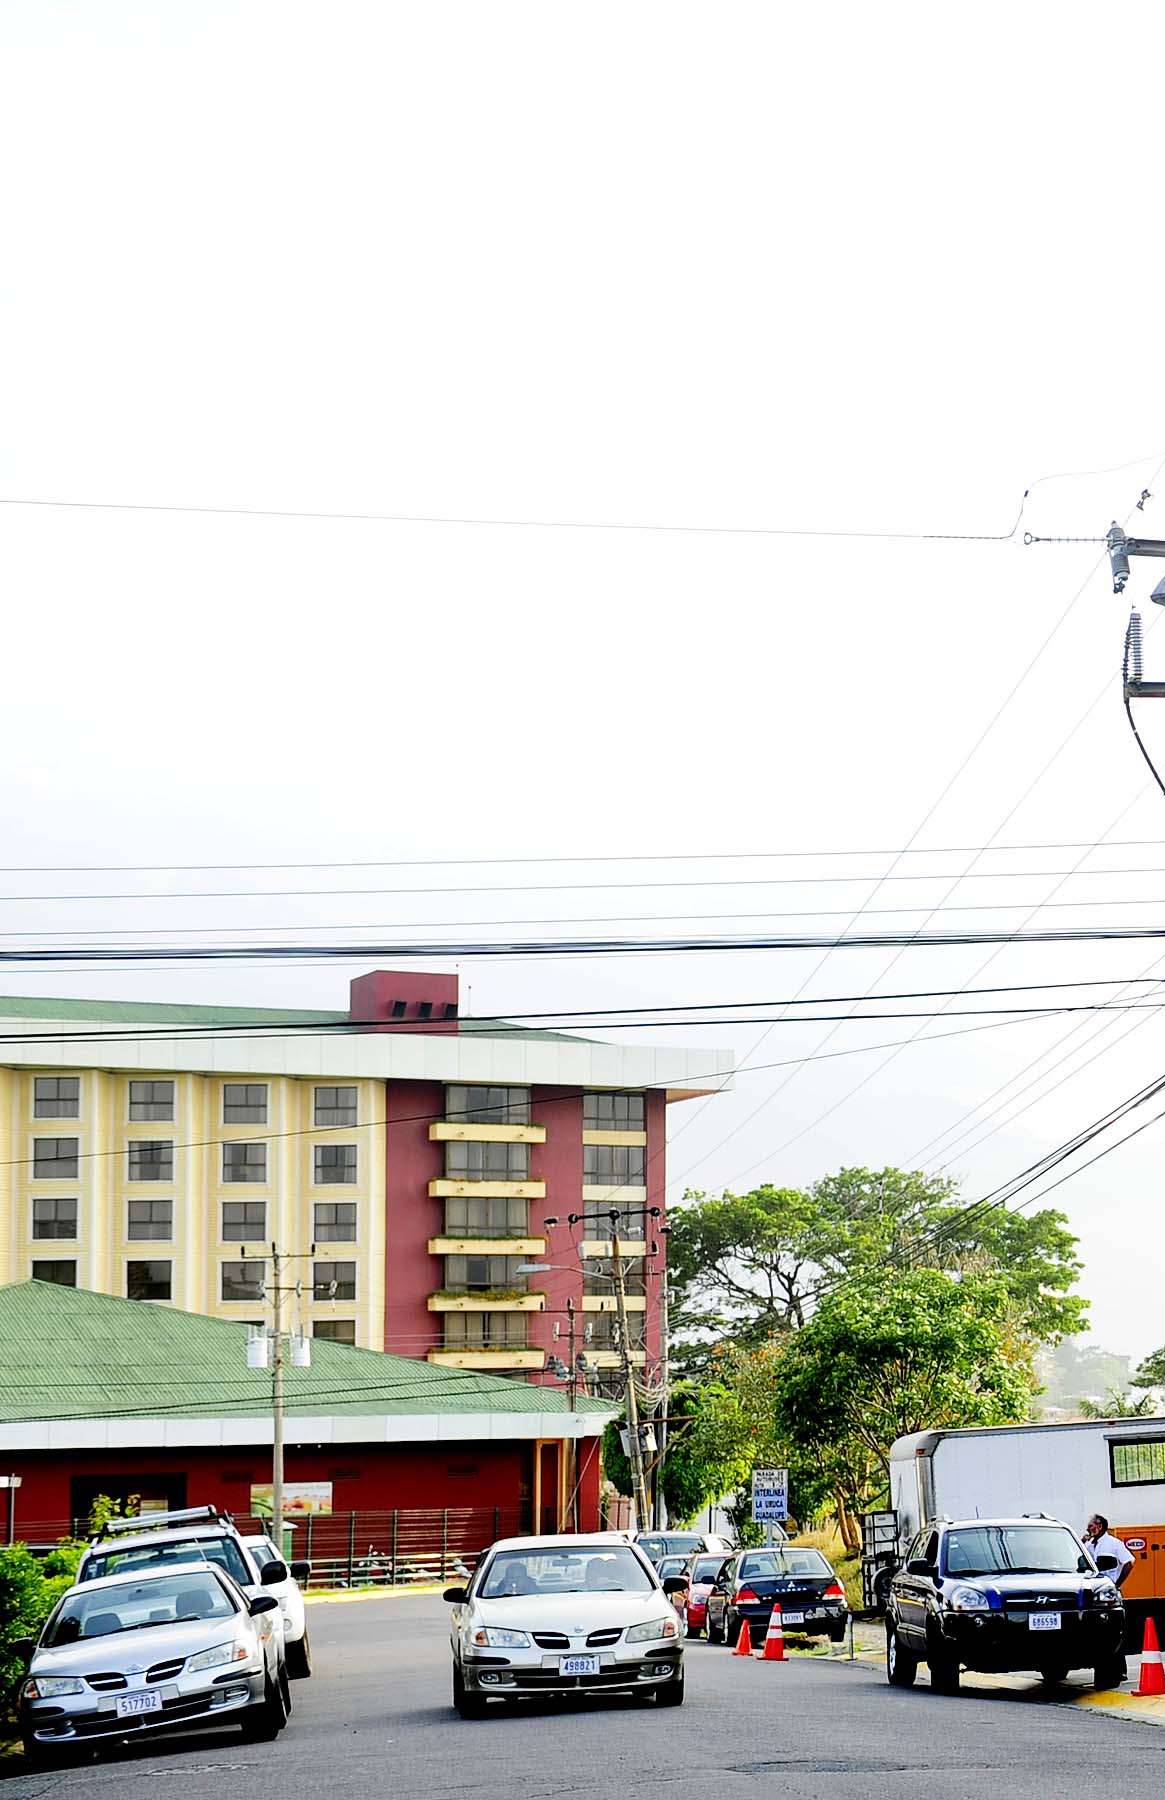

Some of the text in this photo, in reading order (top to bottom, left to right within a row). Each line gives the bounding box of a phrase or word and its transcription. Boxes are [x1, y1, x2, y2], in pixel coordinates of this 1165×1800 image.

[754, 1488, 785, 1497] INTERLINEA
[755, 1500, 784, 1508] LA URUCA
[755, 1511, 785, 1520] GUADALUPE
[564, 1660, 595, 1671] 498821
[121, 1696, 157, 1712] 517702
